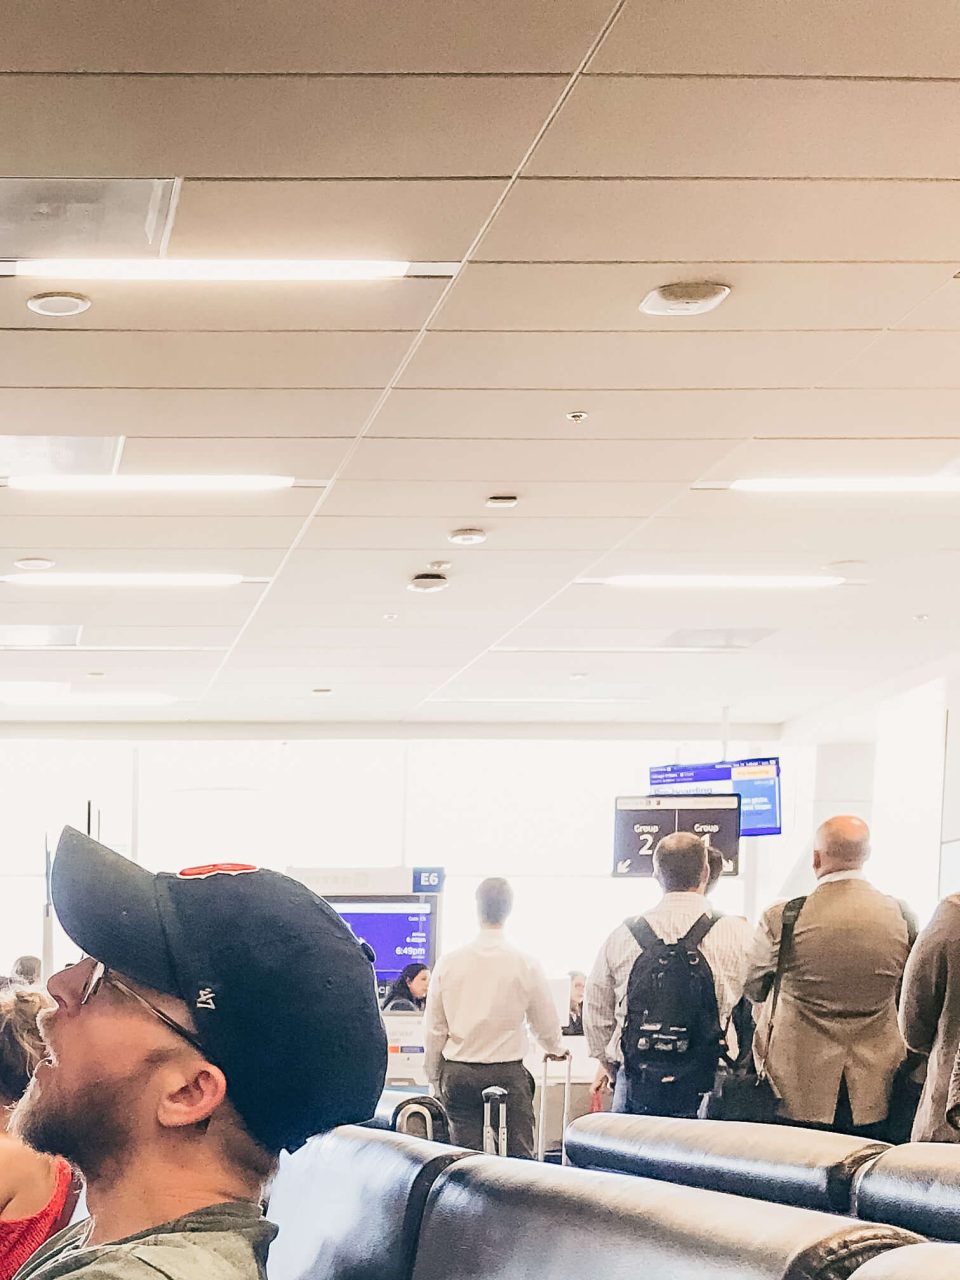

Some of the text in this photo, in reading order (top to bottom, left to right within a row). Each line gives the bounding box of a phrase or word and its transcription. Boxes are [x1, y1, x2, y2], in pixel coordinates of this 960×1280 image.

[634, 824, 659, 833] Group
[694, 823, 719, 833] Group
[638, 834, 654, 855] 2
[700, 834, 711, 847] 1
[420, 873, 439, 886] E6
